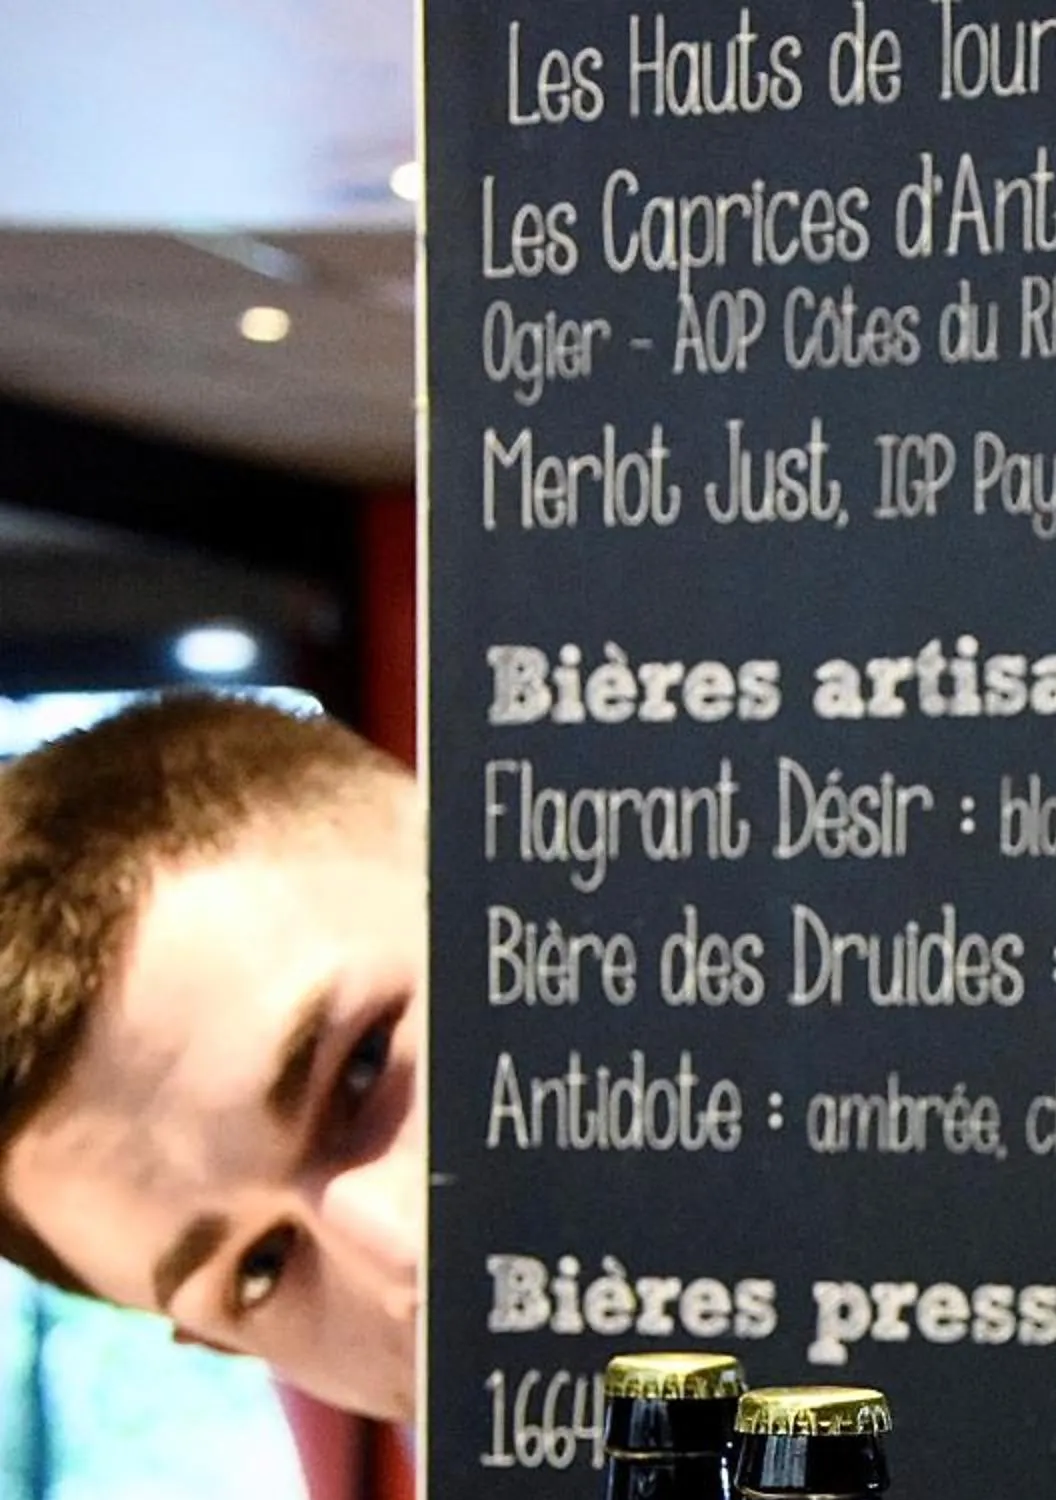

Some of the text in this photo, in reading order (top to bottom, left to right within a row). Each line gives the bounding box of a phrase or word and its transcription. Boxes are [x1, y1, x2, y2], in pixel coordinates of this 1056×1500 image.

[509, 21, 604, 125] Les
[630, 8, 802, 116] Hauts
[830, 0, 901, 106] de
[483, 176, 578, 278] Les
[603, 168, 870, 295] Caprices
[483, 300, 611, 406] Ogier
[673, 283, 765, 374] AOP
[784, 285, 921, 369] Côtes
[940, 279, 998, 363] du
[484, 424, 681, 530] Merlot
[705, 418, 848, 527] Just,
[874, 433, 956, 519] IGP
[487, 642, 780, 723] Bières
[486, 759, 750, 892] Flagrant
[773, 756, 933, 859] Désir
[488, 906, 636, 1005] Bière
[661, 905, 764, 1005] des
[789, 904, 1024, 1006] Druides
[487, 1050, 742, 1150] Antidote
[807, 1073, 1007, 1158] ambrée,
[487, 1255, 776, 1337] Bières
[480, 1369, 605, 1468] 1664
